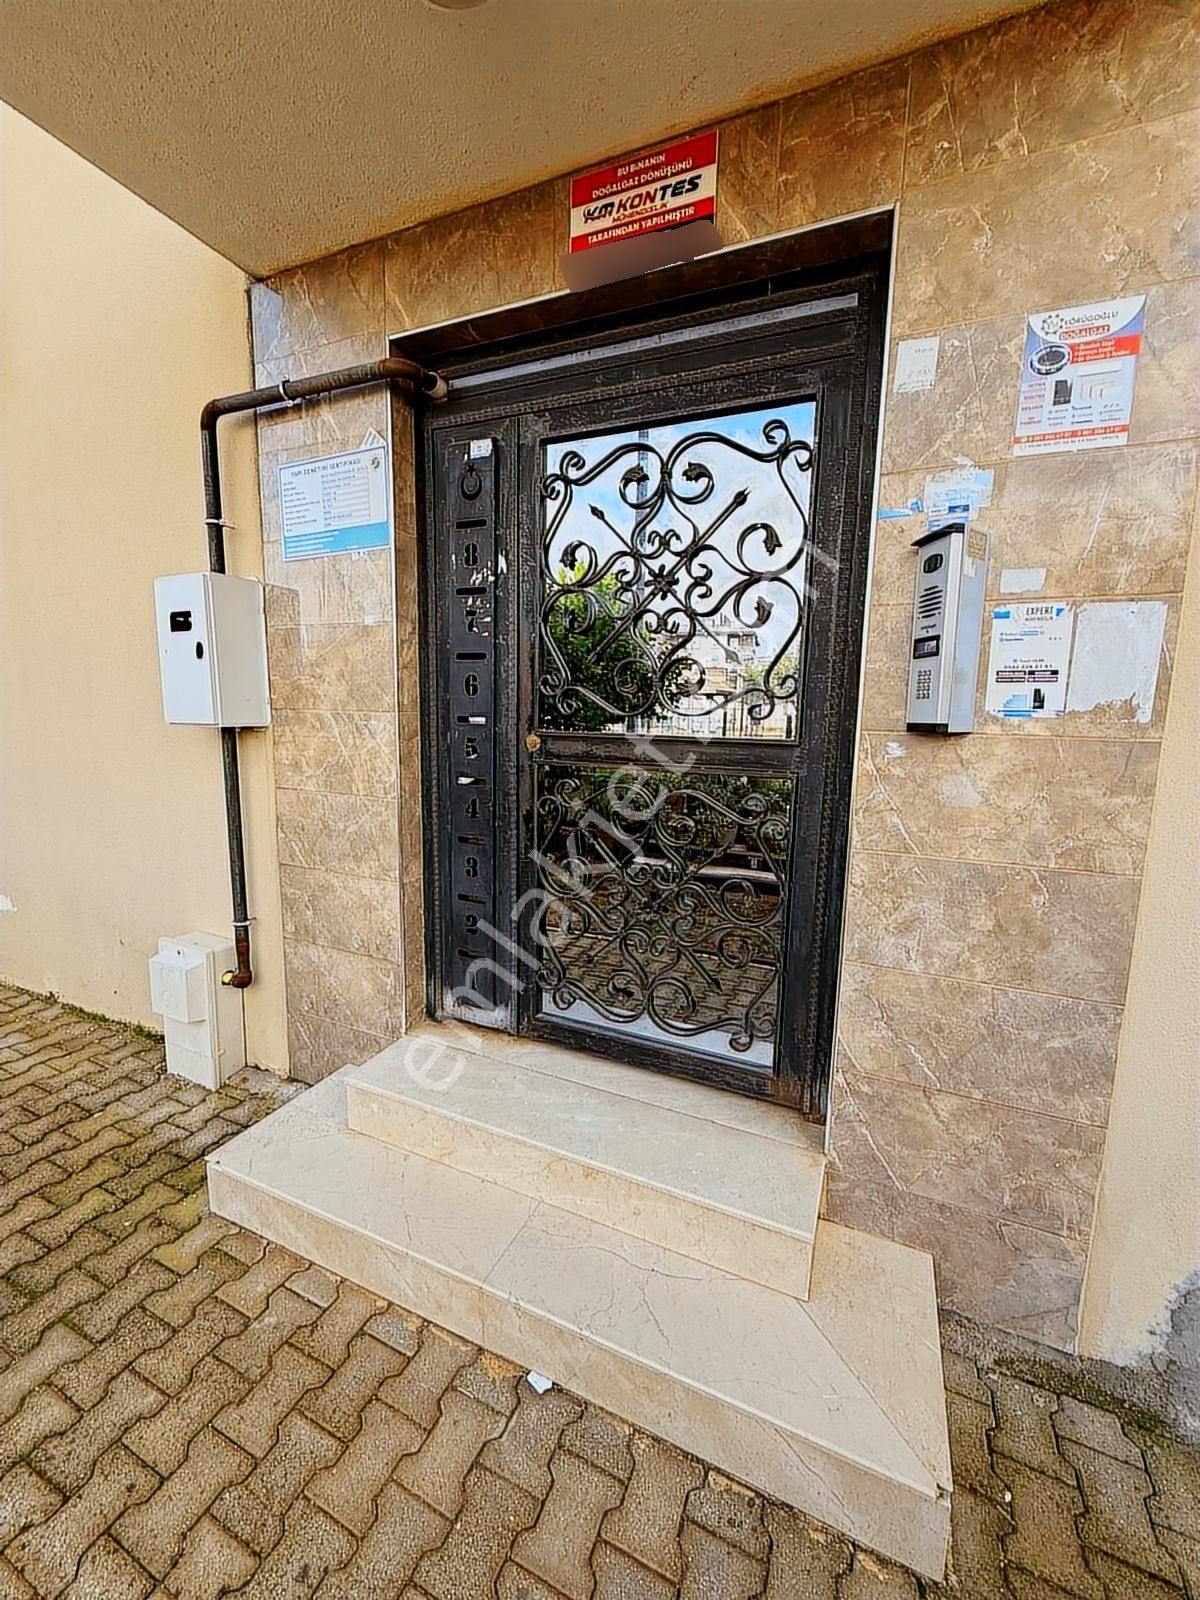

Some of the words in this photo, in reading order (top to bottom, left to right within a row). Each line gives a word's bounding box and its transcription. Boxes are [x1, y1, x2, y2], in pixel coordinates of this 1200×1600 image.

[616, 173, 702, 214] KONTES
[588, 221, 640, 245] TARAFINDAN
[464, 542, 479, 567] 8
[464, 672, 479, 698] 6
[465, 737, 479, 760] 5
[464, 797, 480, 820] 4
[465, 856, 479, 878] 3
[465, 914, 479, 936] 2
